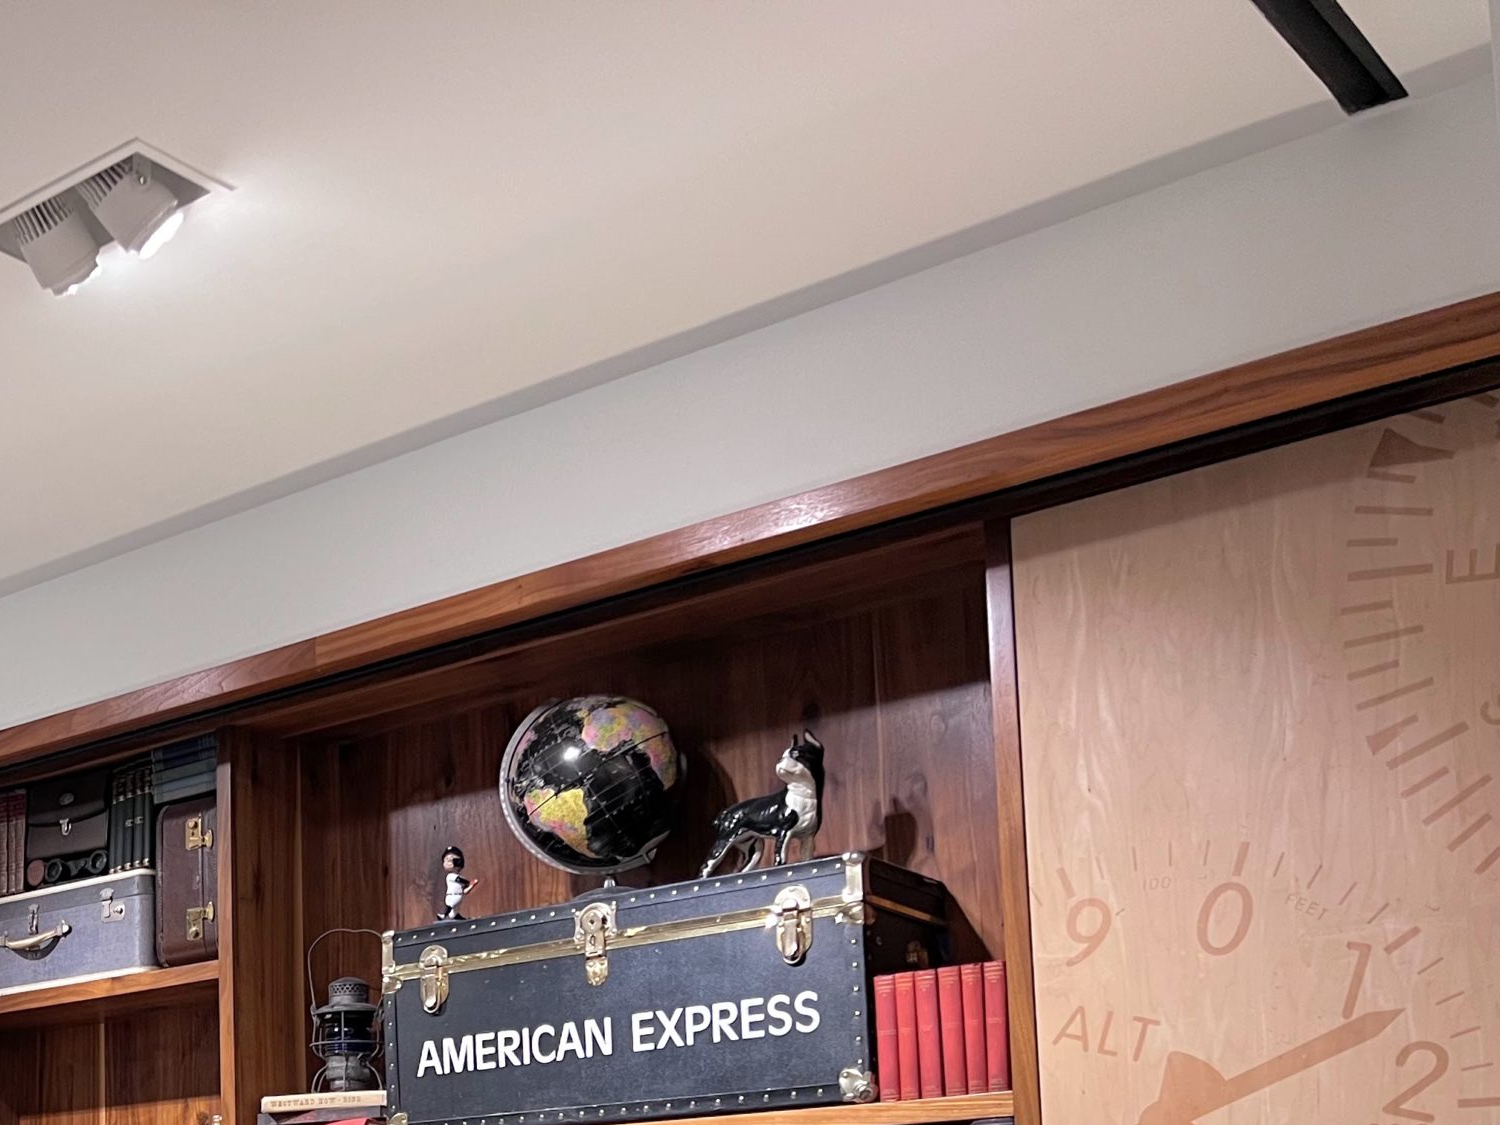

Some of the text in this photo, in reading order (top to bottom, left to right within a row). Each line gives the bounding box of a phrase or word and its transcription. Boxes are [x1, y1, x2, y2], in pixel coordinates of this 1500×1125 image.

[1066, 897, 1112, 967] 9
[1197, 881, 1254, 956] 0
[1284, 892, 1330, 921] FEET
[416, 990, 821, 1078] AMERICAN EXPRESS
[1052, 1005, 1161, 1062] ALT
[1381, 1040, 1450, 1123] 2
